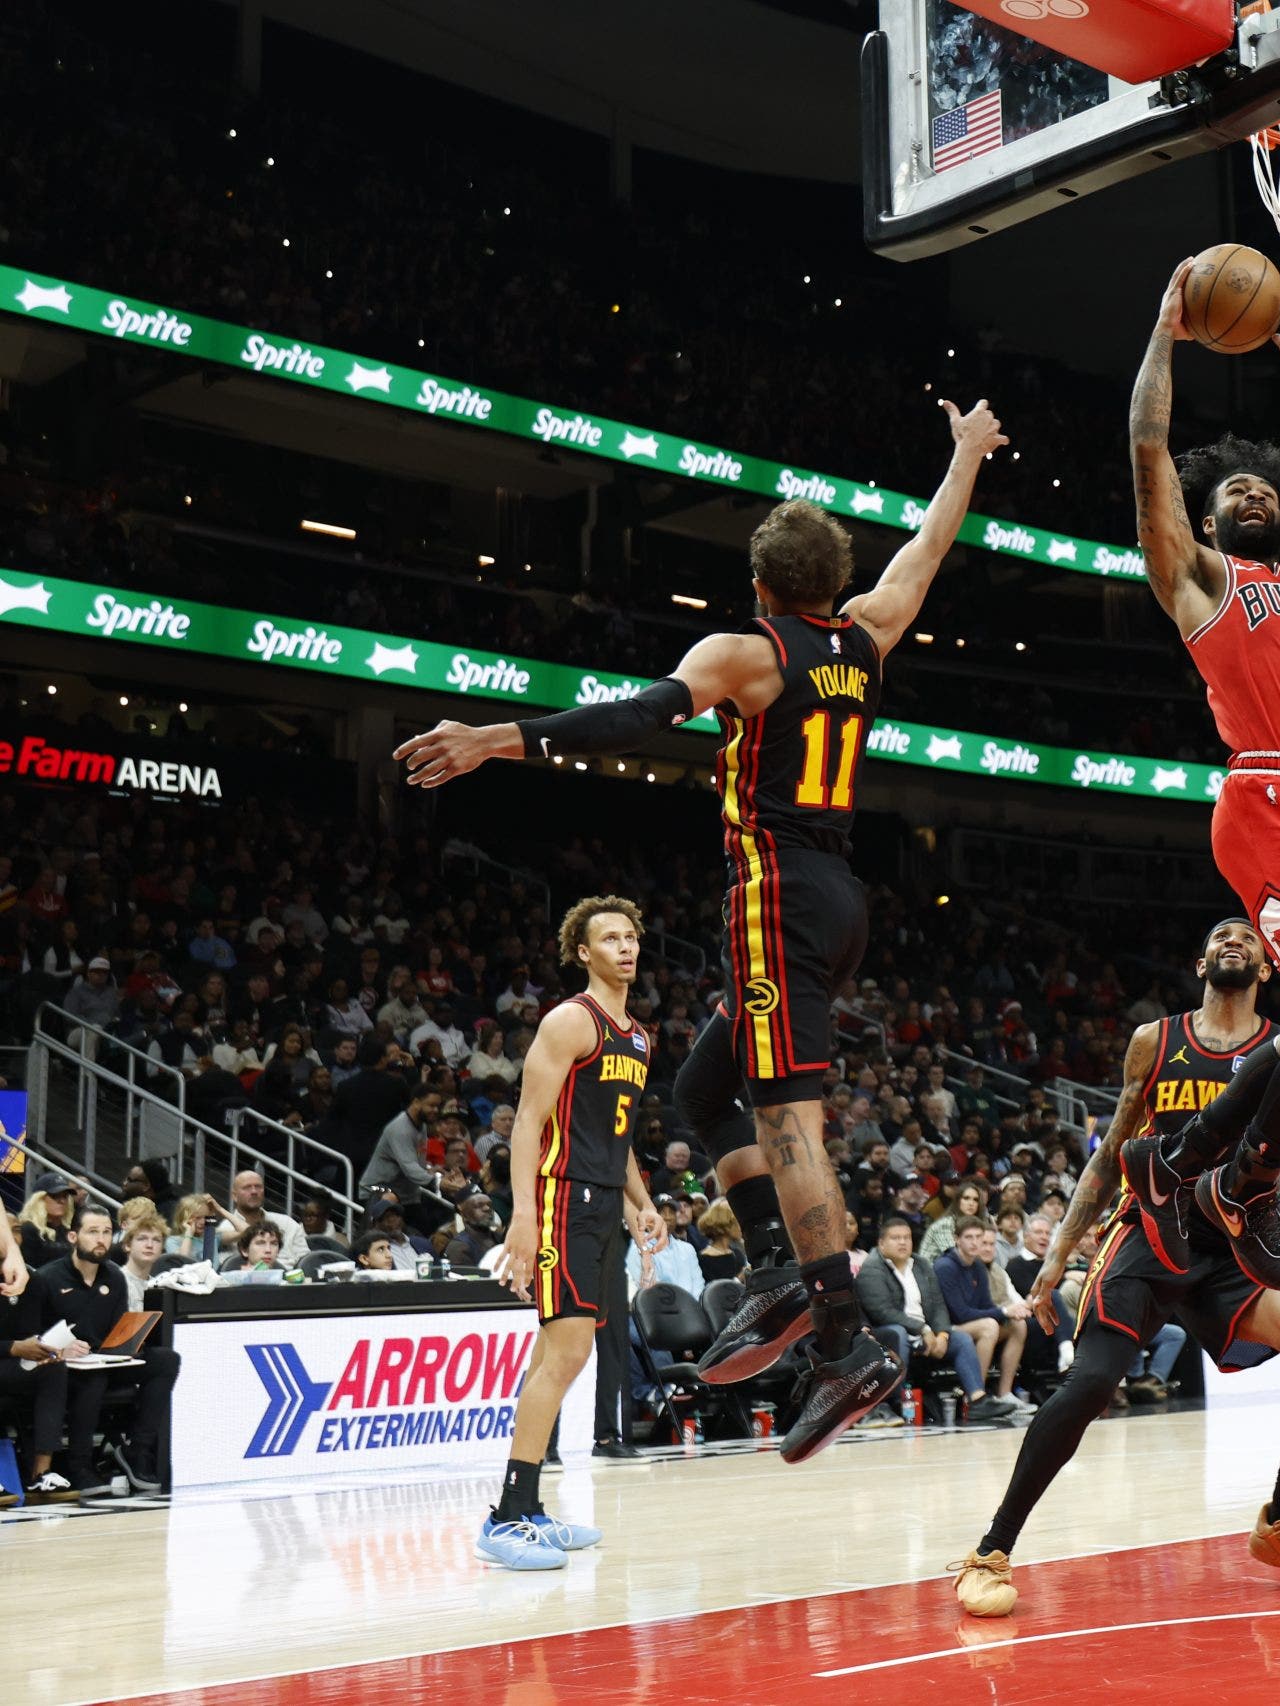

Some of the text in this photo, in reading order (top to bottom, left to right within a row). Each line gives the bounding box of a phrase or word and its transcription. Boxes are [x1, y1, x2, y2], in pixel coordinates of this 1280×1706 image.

[102, 300, 192, 345] Sprite
[242, 335, 324, 378] Sprite
[417, 379, 491, 419] Sprite
[533, 409, 602, 446] Sprite
[678, 445, 742, 481] Sprite
[776, 470, 836, 503] Sprite
[984, 522, 1035, 553] Sprite
[86, 594, 190, 638] Sprite
[248, 621, 342, 663] Sprite
[446, 654, 530, 693] Sprite
[980, 742, 1039, 774] Sprite
[1072, 755, 1136, 787] Sprite
[808, 664, 868, 703] YOUNG
[16, 736, 116, 785] Farm
[116, 756, 222, 798] ARENA
[795, 709, 863, 811] 11
[599, 1054, 648, 1091] HAWKS
[1155, 1079, 1229, 1113] HAW
[614, 1093, 632, 1136] 5
[327, 1331, 534, 1411] ARROW
